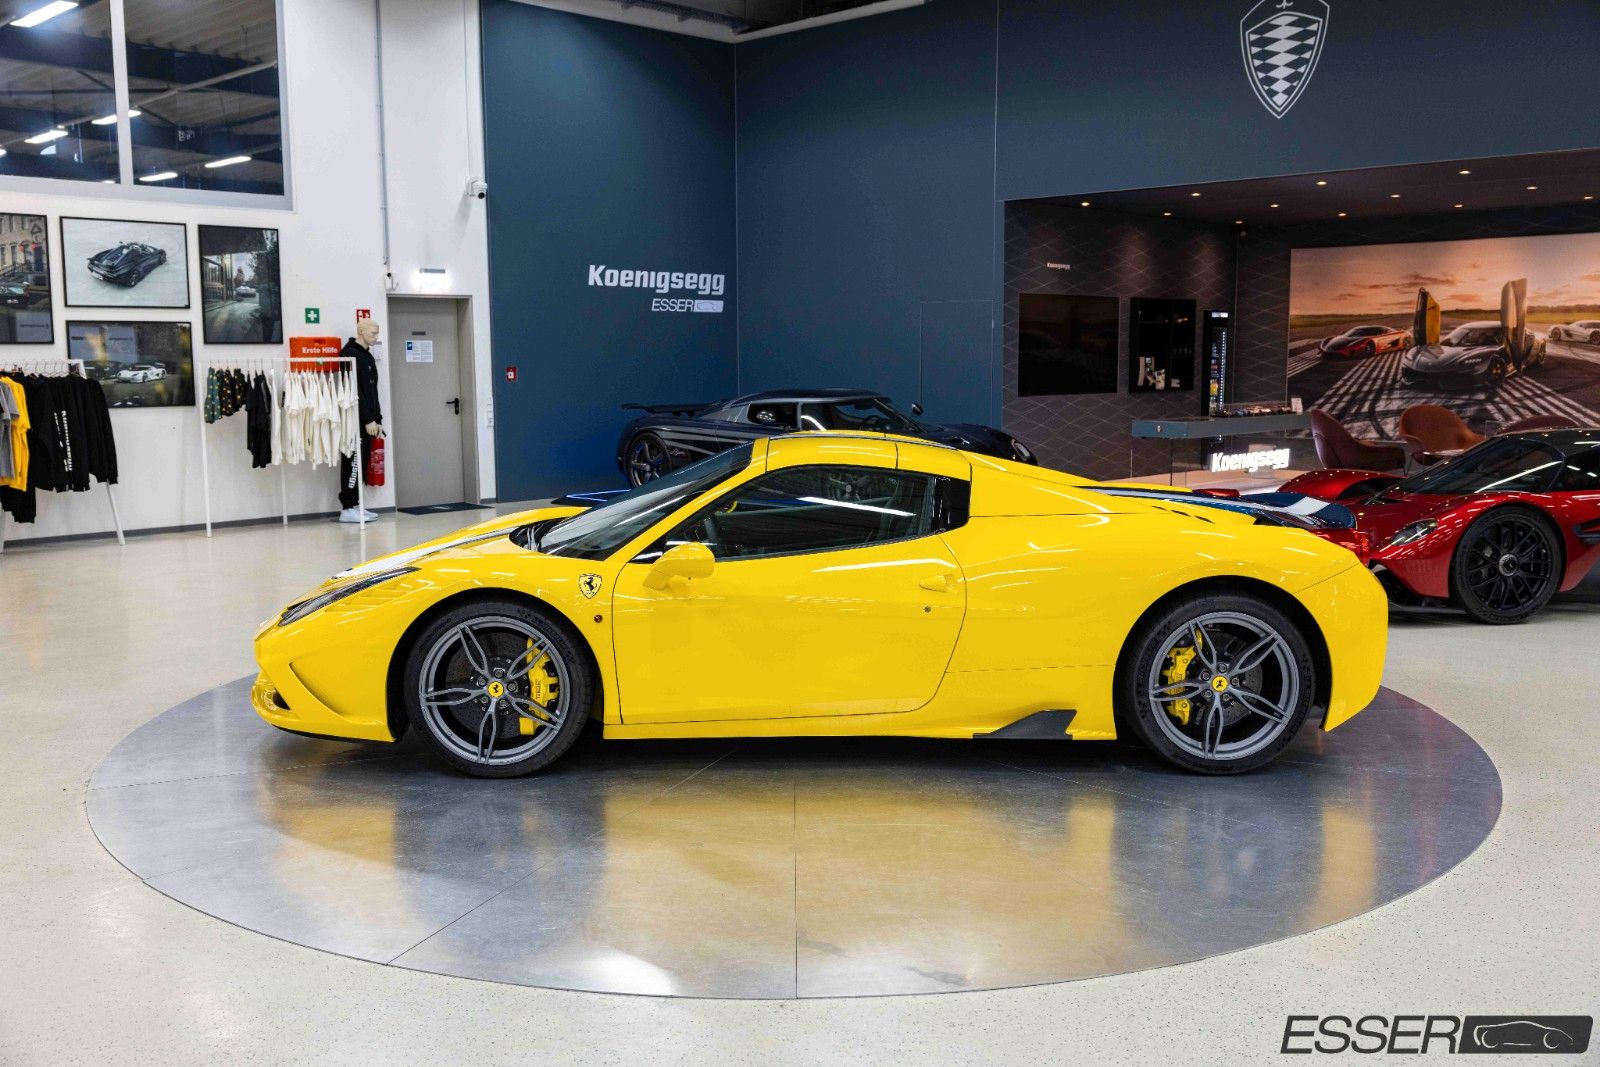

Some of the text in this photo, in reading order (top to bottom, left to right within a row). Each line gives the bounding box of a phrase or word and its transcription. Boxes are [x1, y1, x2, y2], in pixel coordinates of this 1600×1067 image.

[588, 264, 725, 295] Koenigsegg
[651, 298, 694, 312] ESSER
[302, 346, 339, 354] Erste Hilfe
[1211, 448, 1290, 473] Koenigsegg
